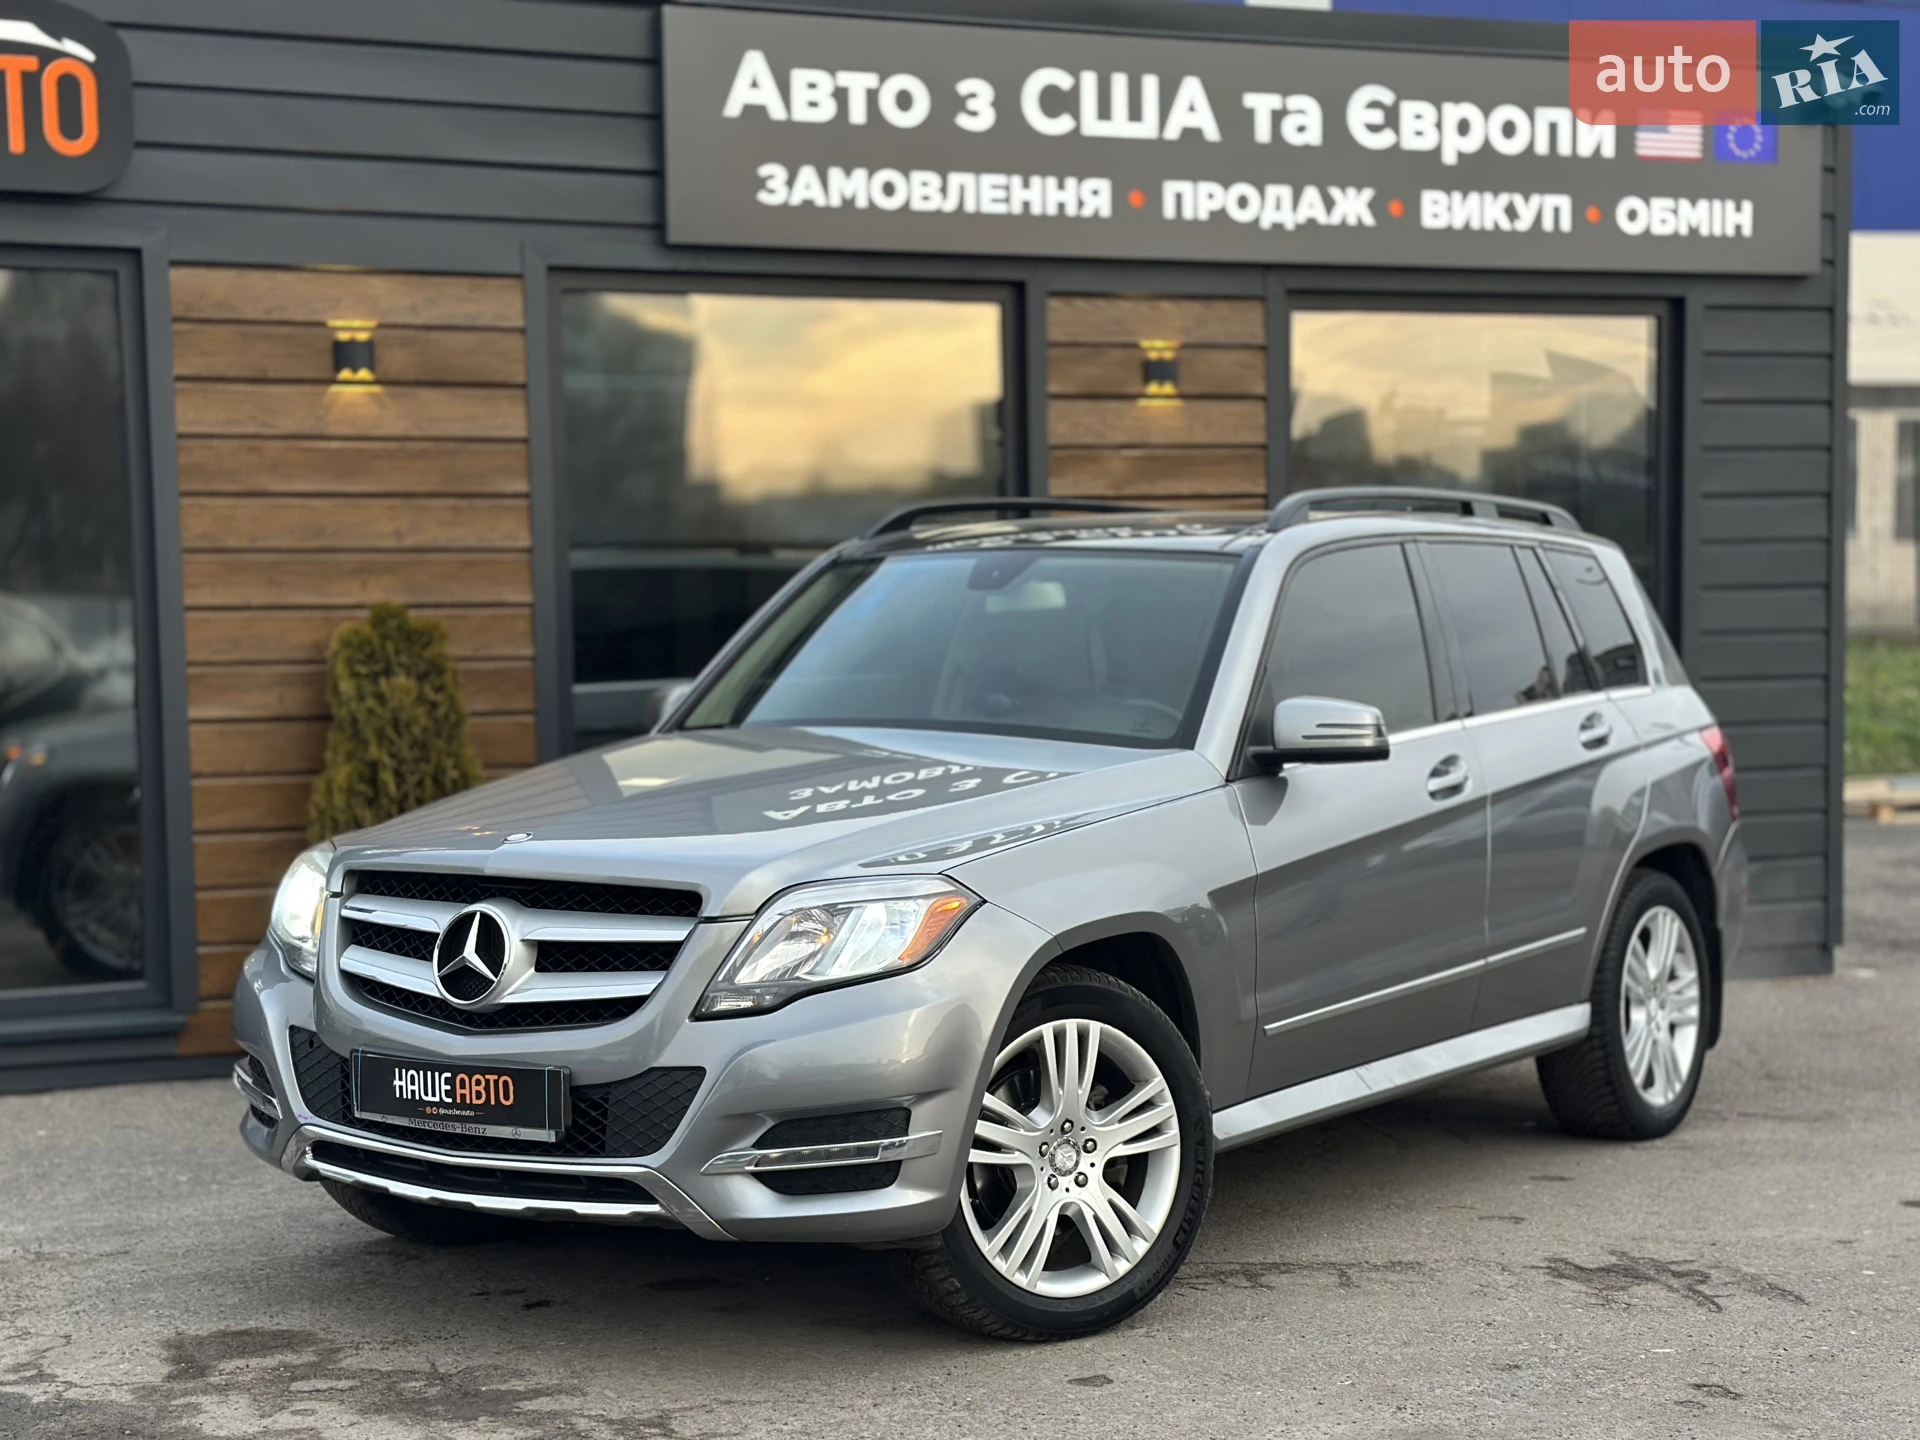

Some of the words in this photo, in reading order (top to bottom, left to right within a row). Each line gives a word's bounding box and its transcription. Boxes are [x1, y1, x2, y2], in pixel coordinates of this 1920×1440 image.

[723, 49, 932, 129] Авто
[954, 77, 997, 132] з
[1020, 67, 1222, 142] США
[1243, 91, 1323, 147] та
[1346, 83, 1616, 165] Європи
[756, 162, 1113, 219] ЗАМОВЛЕННЯ
[1162, 179, 1376, 231] ПРОДАЖ
[1420, 189, 1572, 233] ВИКУП
[1615, 195, 1753, 238] ОБМІН
[393, 1067, 453, 1103] НАШЕ
[455, 1073, 514, 1106] АВТО
[408, 1118, 487, 1135] Mercedes-Benz
